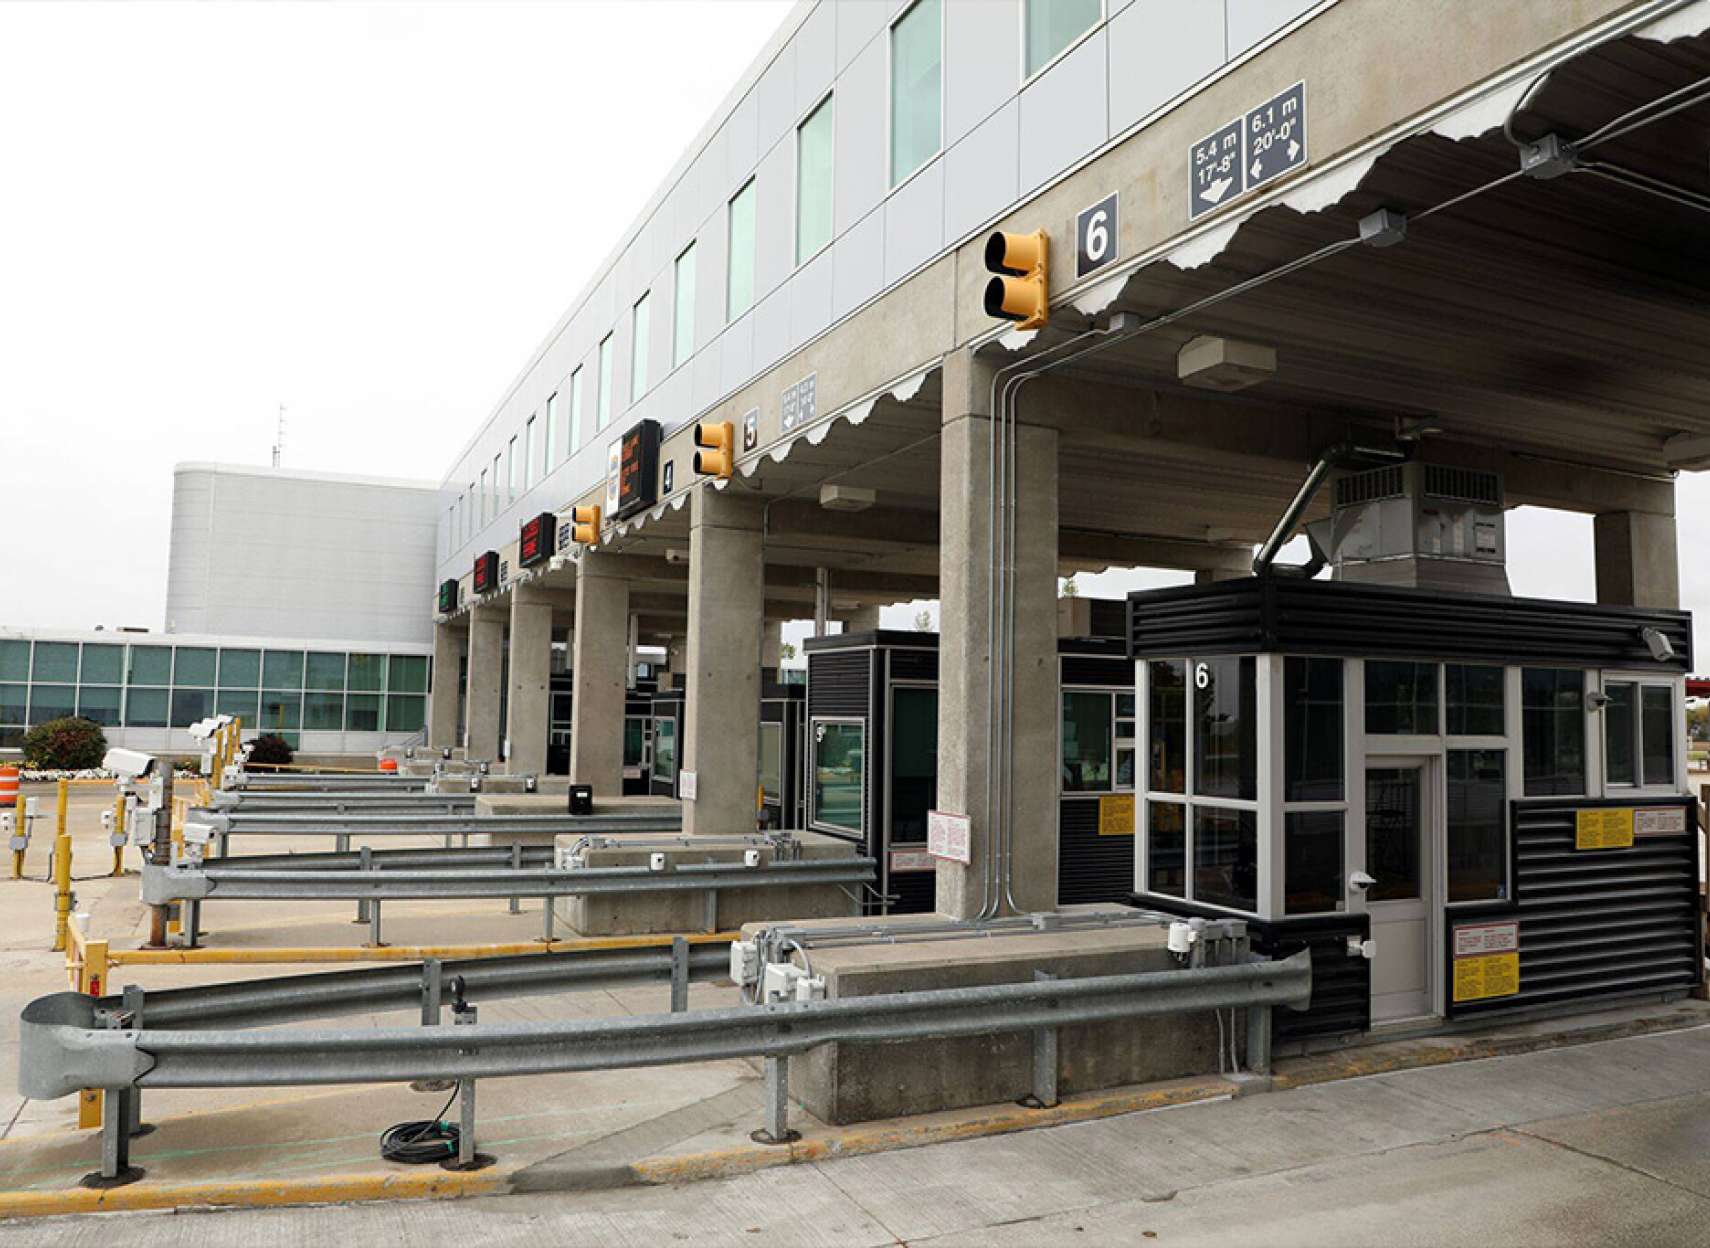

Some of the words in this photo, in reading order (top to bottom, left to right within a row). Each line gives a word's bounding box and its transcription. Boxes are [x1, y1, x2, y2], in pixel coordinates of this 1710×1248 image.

[1252, 107, 1274, 132] 6.1
[1282, 96, 1297, 113] m
[1196, 147, 1217, 166] 5.4
[1223, 131, 1236, 149] m
[1086, 210, 1108, 262] 6
[746, 416, 754, 445] 5
[1195, 662, 1209, 689] 6
